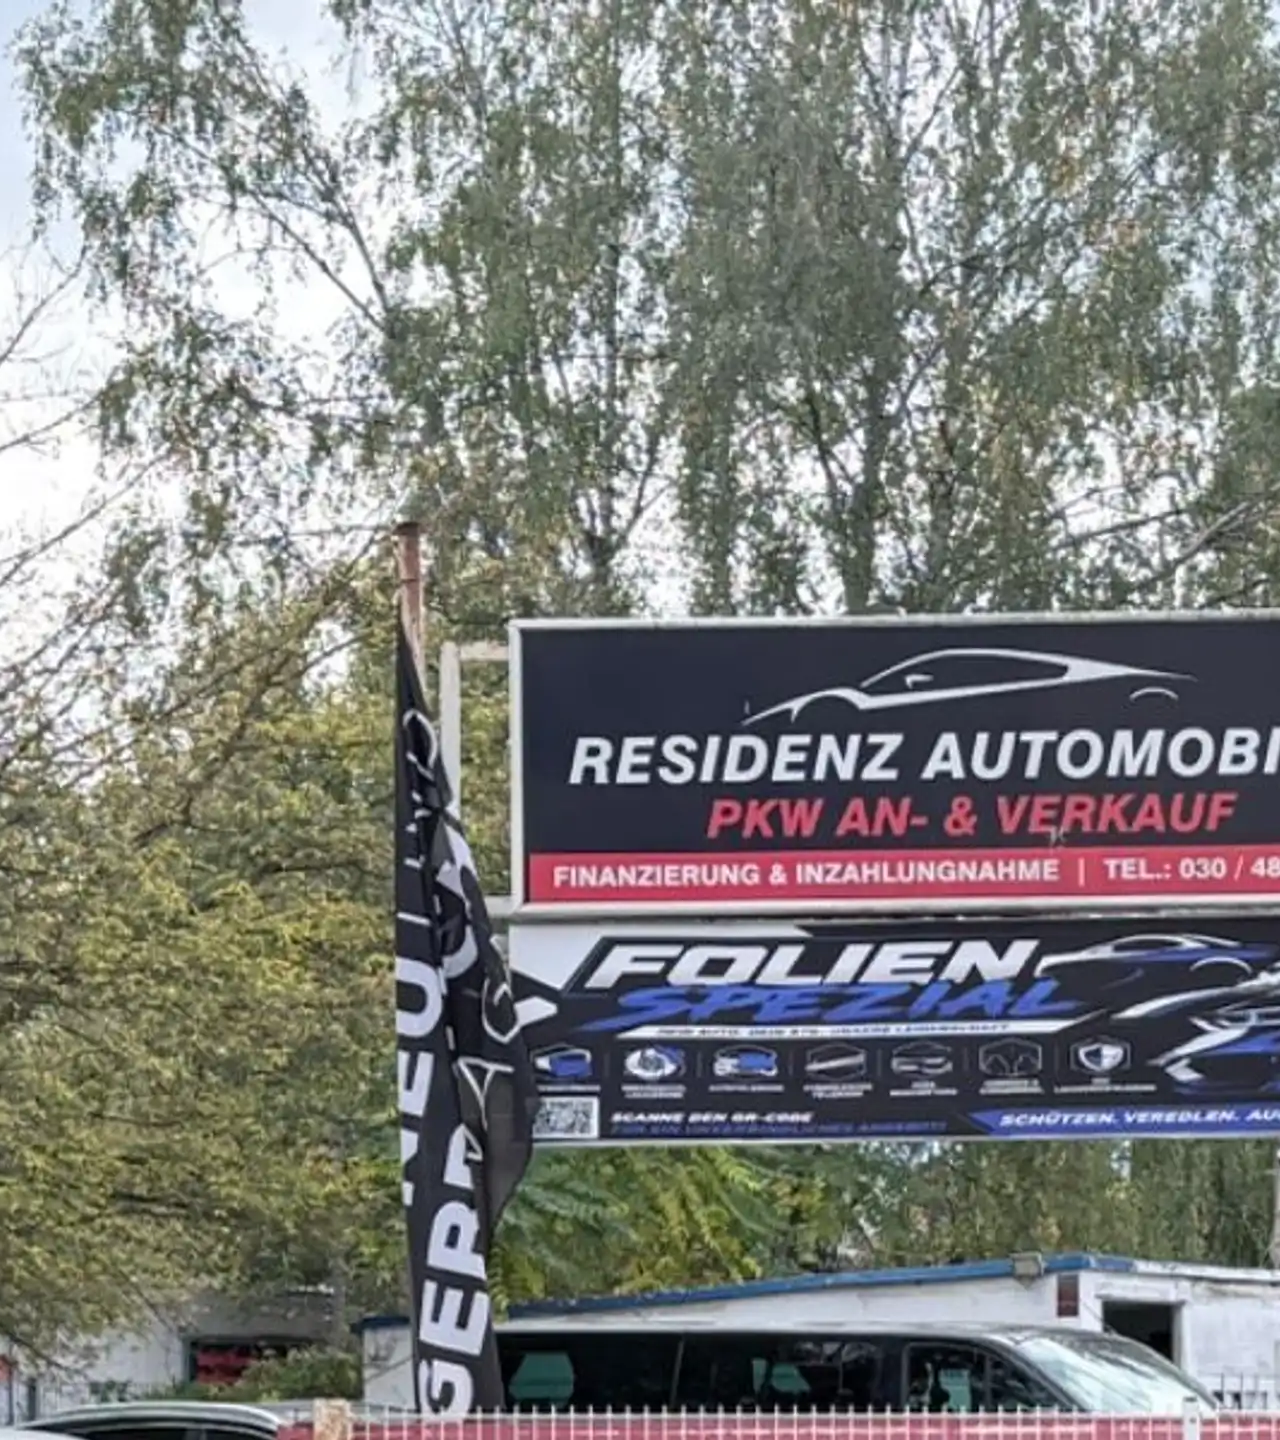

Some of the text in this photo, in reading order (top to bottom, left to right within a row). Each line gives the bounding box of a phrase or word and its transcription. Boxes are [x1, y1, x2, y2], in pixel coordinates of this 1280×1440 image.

[568, 733, 904, 784] RESIDENZ
[706, 792, 1239, 839] PKW AN- & VERKAUF
[553, 862, 760, 888] FINANZIERUNG
[768, 862, 787, 885] &
[796, 858, 1060, 885] INZAHLUNGNAHME
[1103, 859, 1171, 881] TEL.:
[1178, 856, 1227, 880] 030
[1234, 857, 1245, 881] /
[585, 939, 1040, 990] FOLIEN
[576, 977, 1081, 1033] SPEZIAL
[999, 1110, 1118, 1128] SCHÜTZEN.
